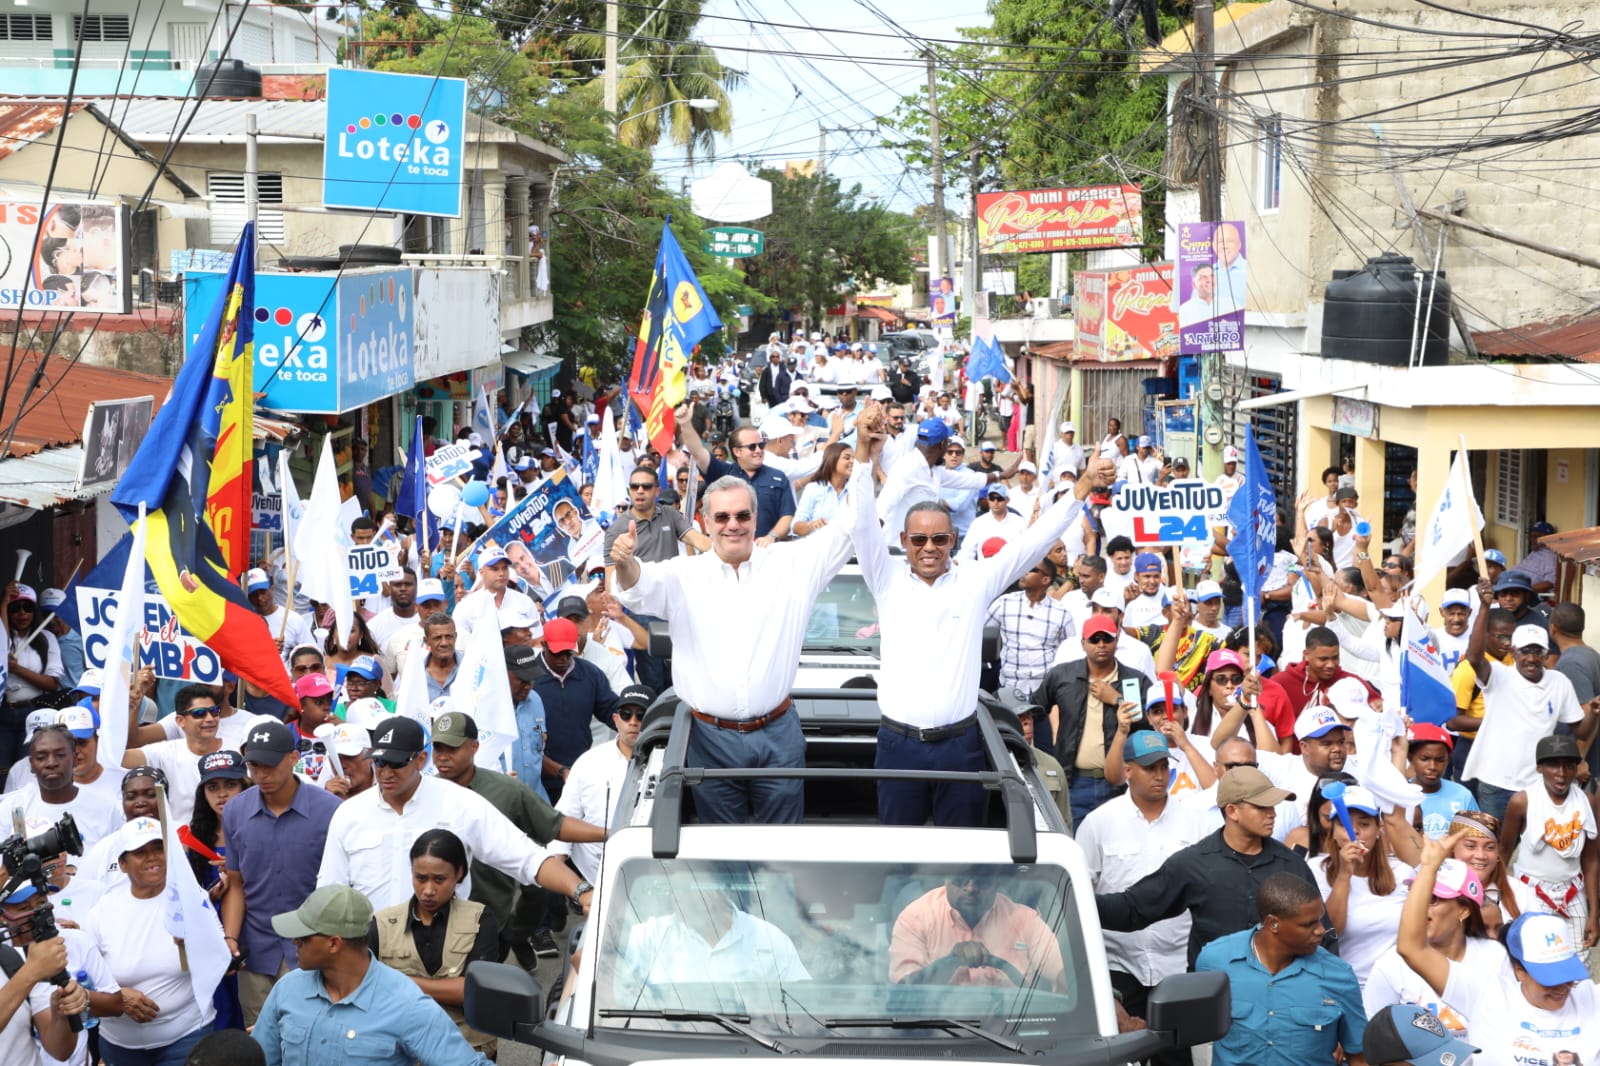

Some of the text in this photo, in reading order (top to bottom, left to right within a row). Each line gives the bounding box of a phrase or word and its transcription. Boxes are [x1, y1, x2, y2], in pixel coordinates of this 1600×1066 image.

[338, 132, 450, 166] Loteka
[407, 164, 449, 177] te toca
[1030, 187, 1122, 204] MINI MARKET
[984, 193, 1117, 236] Rosario
[0, 288, 58, 306] SHOP
[1184, 332, 1239, 345] ARTURO
[346, 320, 409, 383] Loteka
[277, 367, 327, 382] te toca
[1116, 482, 1223, 512] JUVENTUD
[520, 509, 552, 544] L24
[1133, 514, 1209, 542] L24
[1513, 1055, 1549, 1066] VICE
